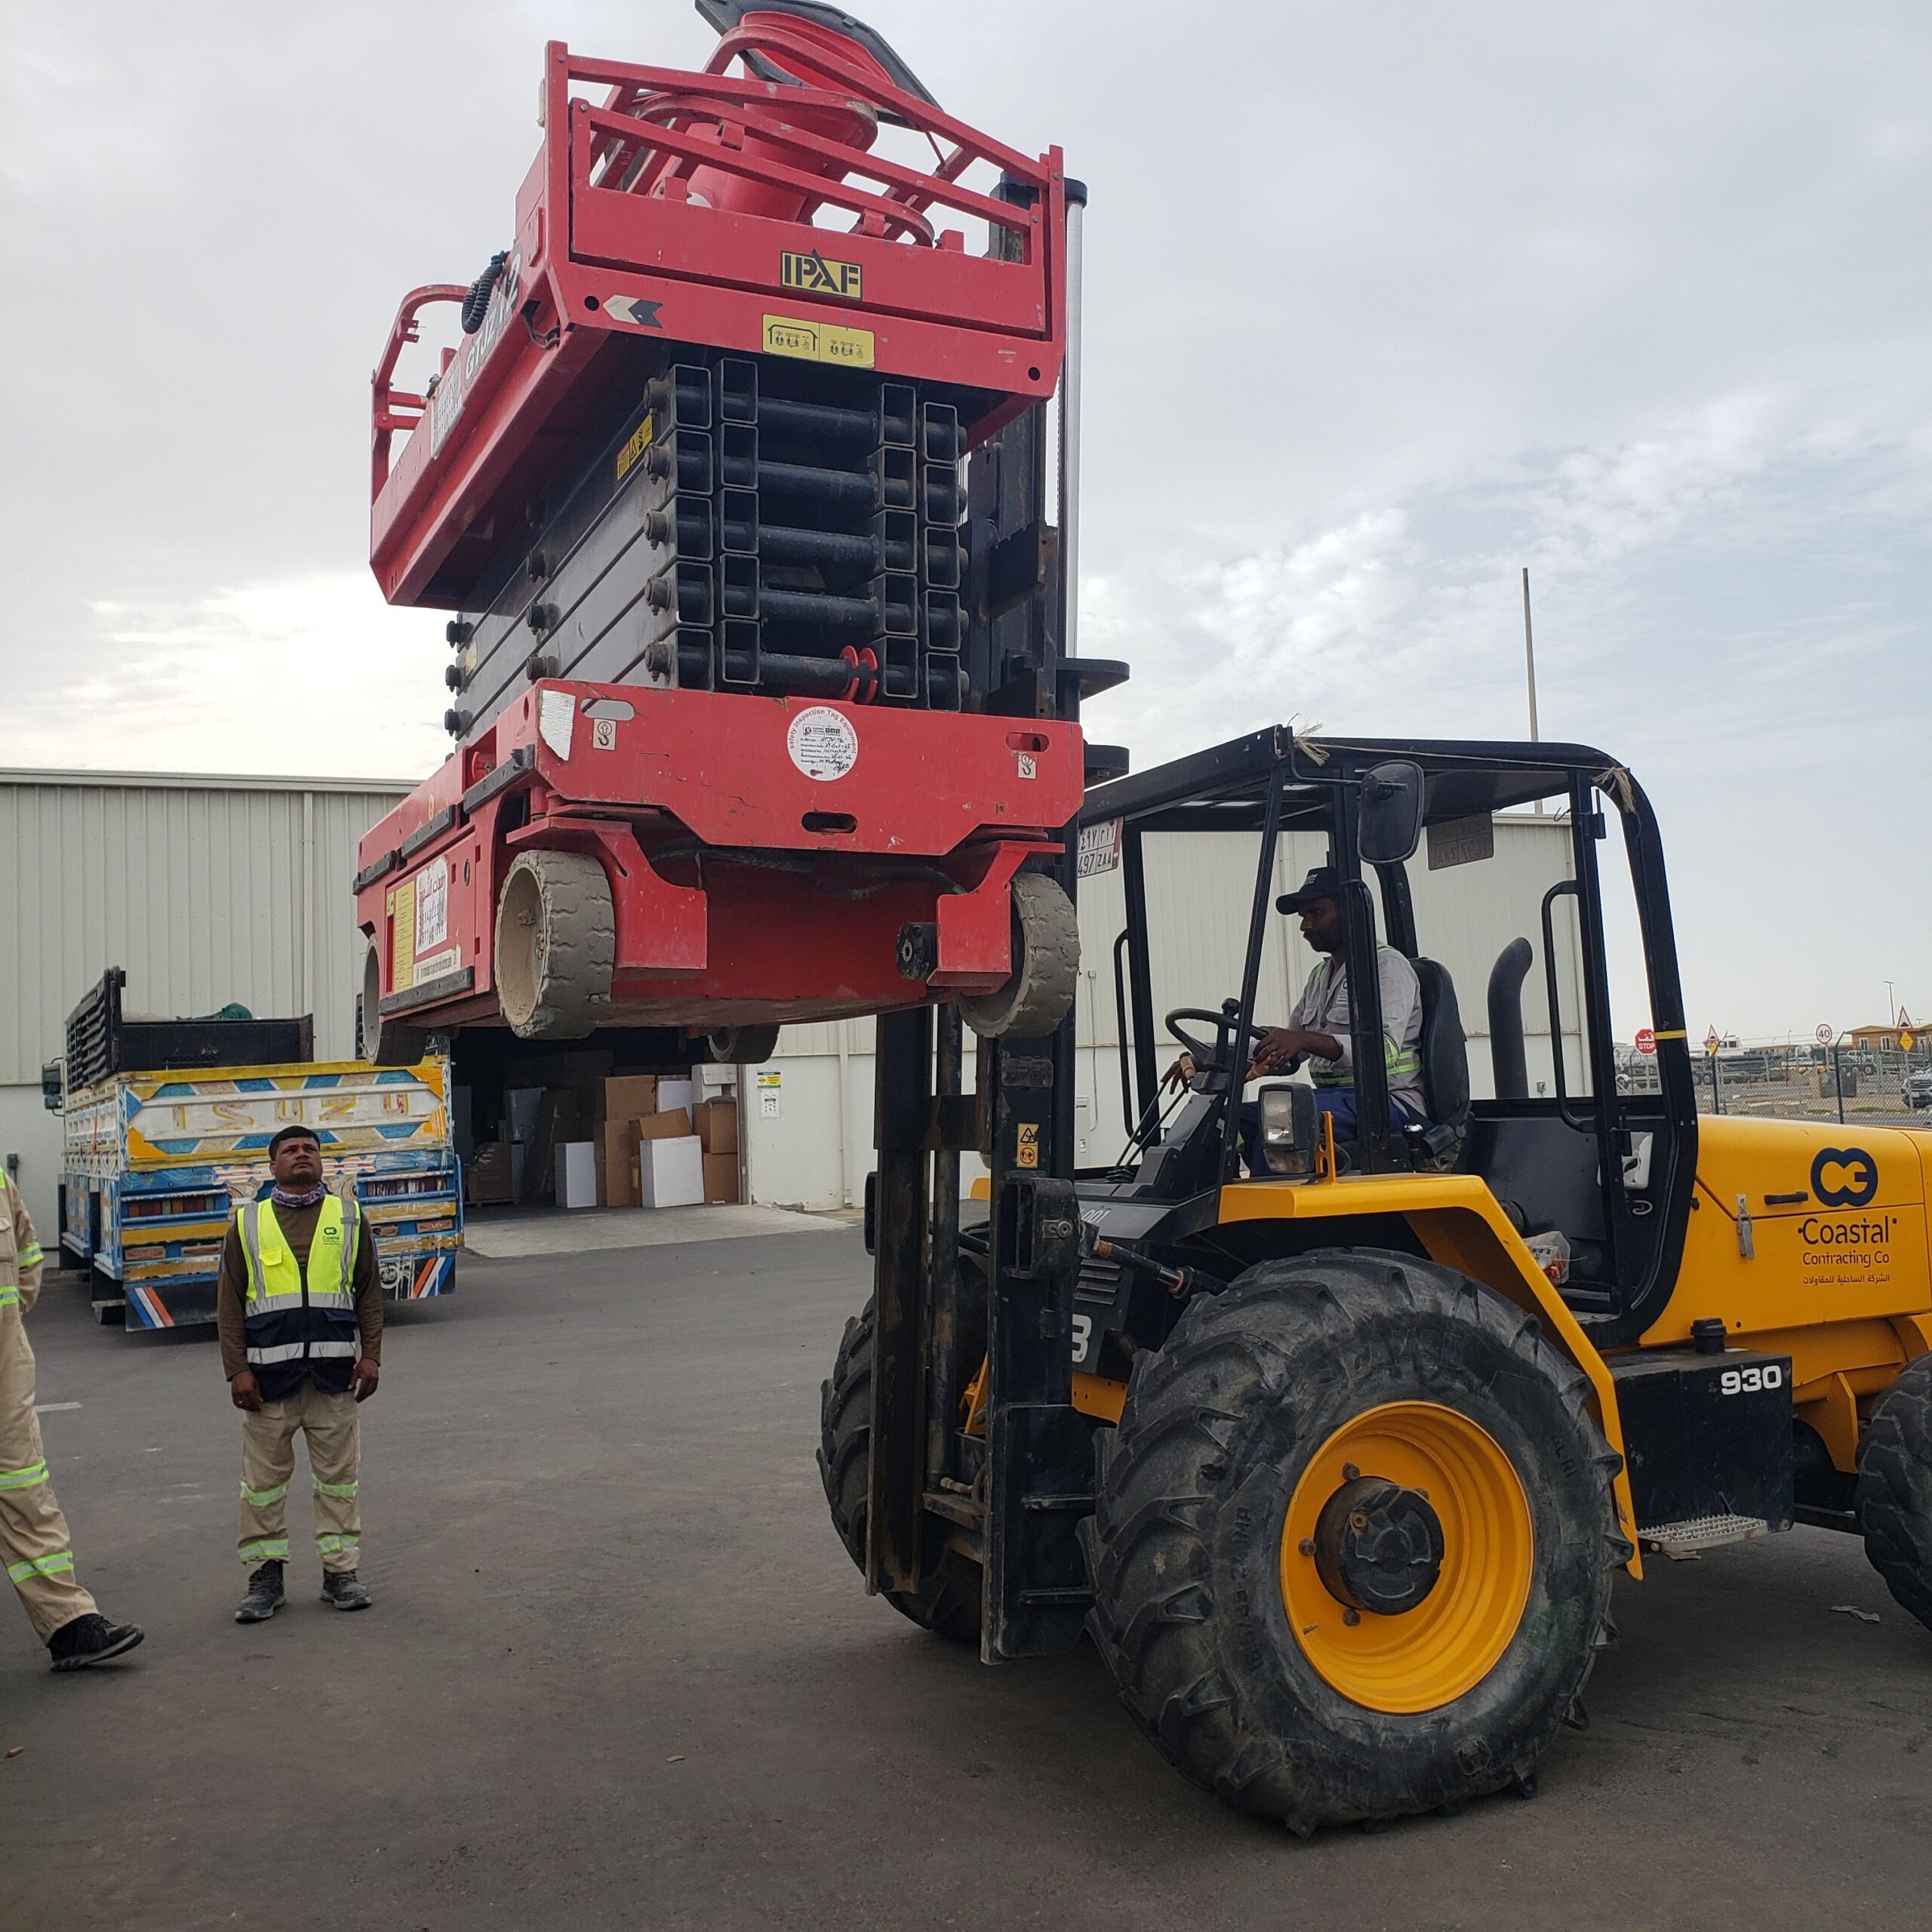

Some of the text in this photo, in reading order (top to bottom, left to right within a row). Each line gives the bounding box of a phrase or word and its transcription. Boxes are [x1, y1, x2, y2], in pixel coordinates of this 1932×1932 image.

[784, 248, 859, 294] IPAF
[1818, 1029, 1830, 1038] 40
[171, 1093, 409, 1129] ISUZU
[1802, 1215, 1890, 1244] Coastal
[1802, 1249, 1890, 1268] Contracting Co
[1802, 1274, 1890, 1286] الشركة الساحلية للمقاولات
[1721, 1364, 1783, 1395] 930
